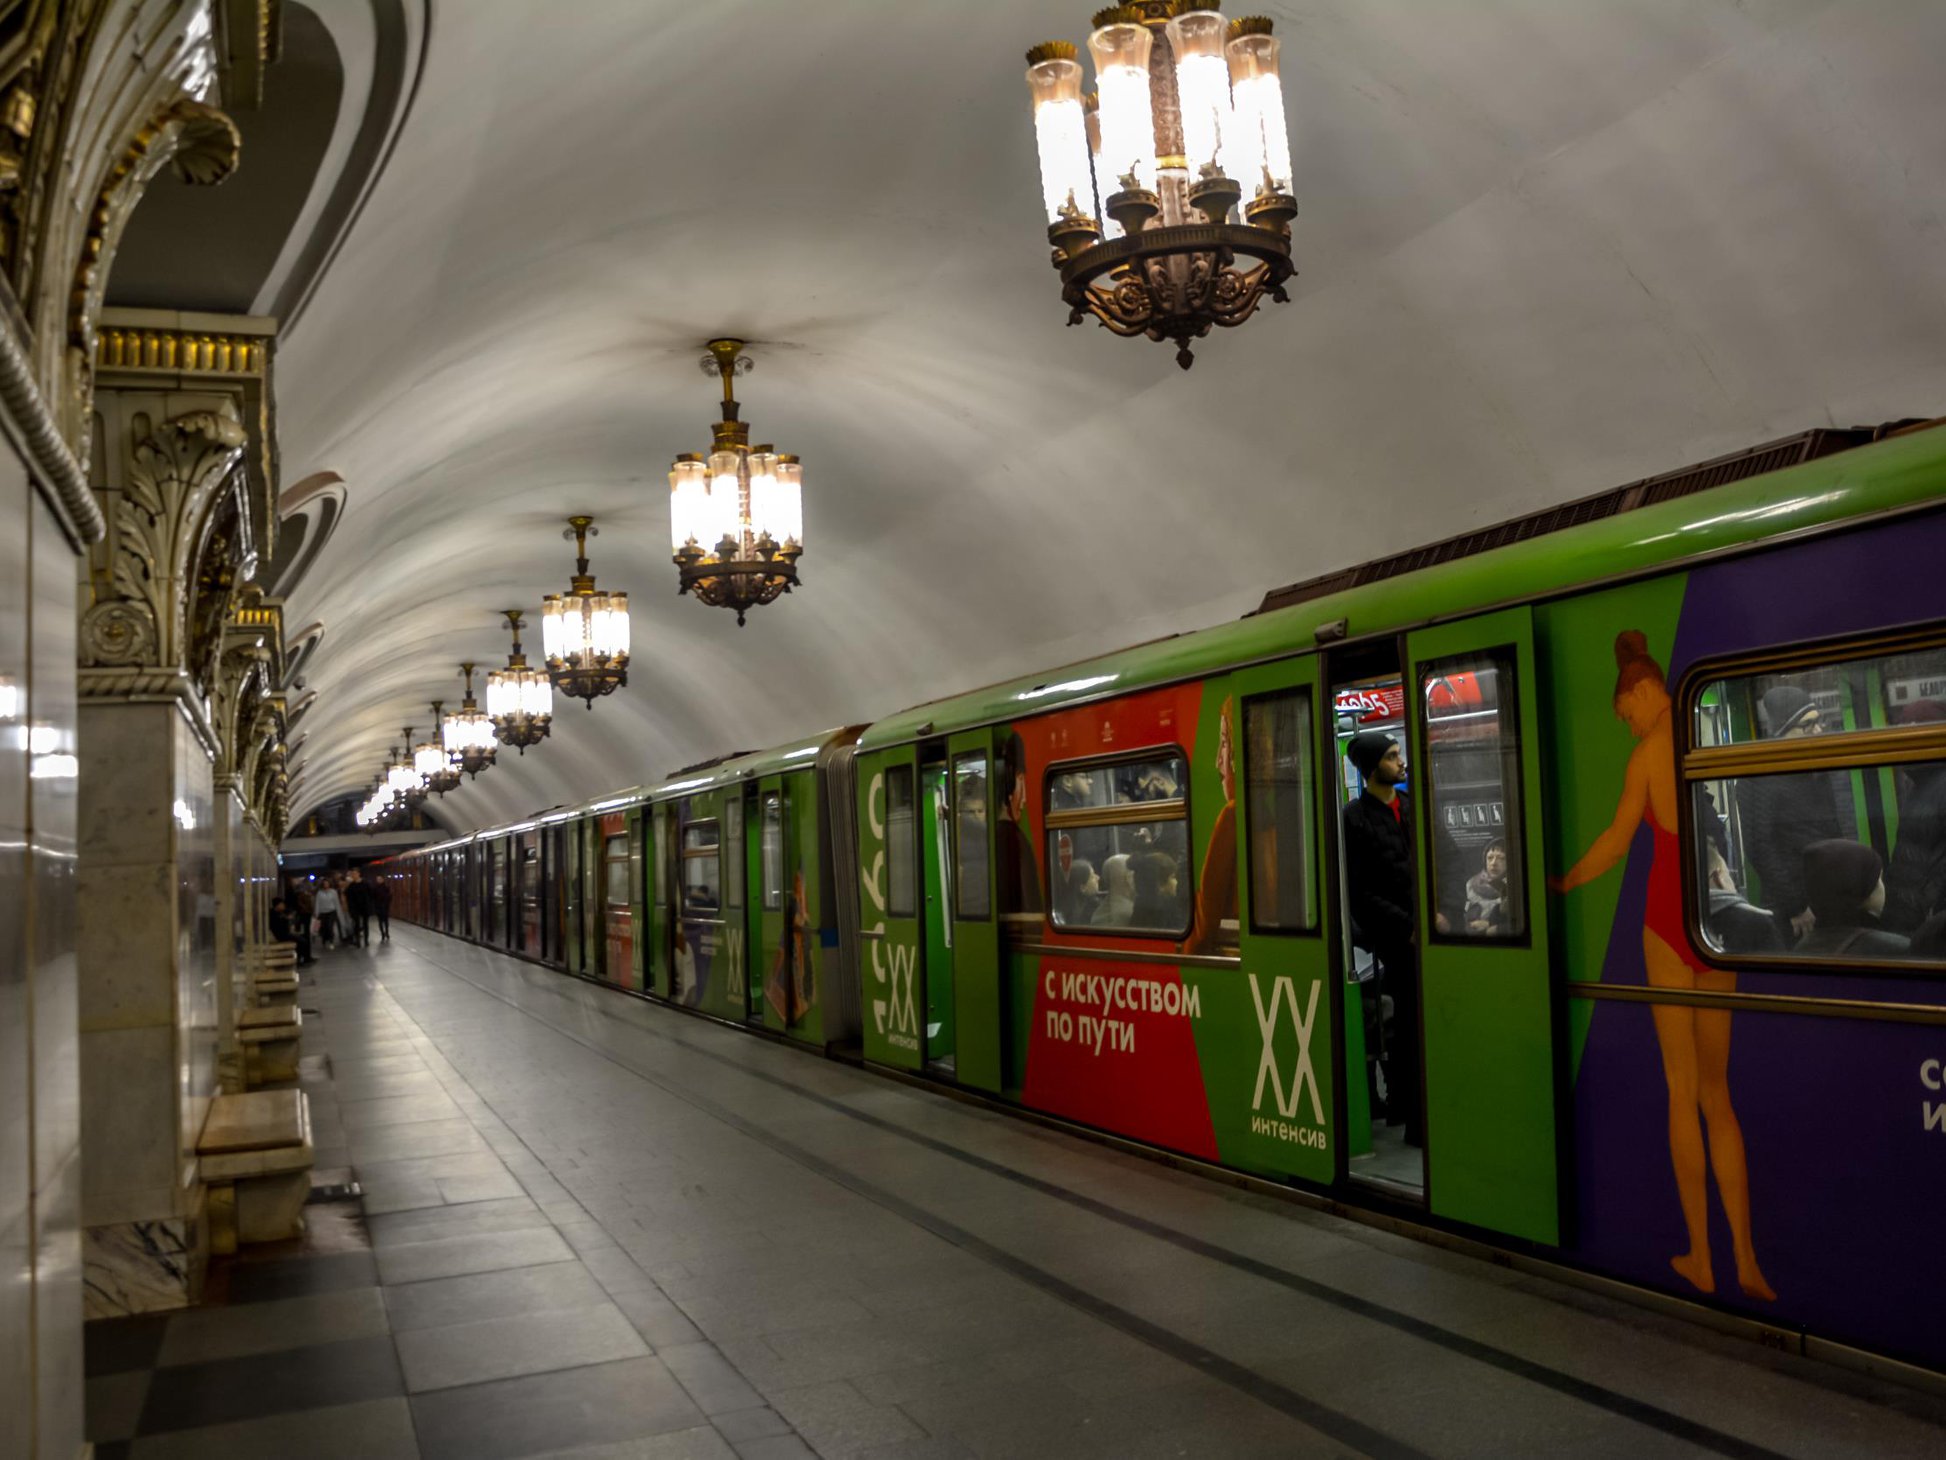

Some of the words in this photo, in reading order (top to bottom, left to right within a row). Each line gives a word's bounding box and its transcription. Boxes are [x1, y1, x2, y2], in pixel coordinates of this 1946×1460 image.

[1062, 973, 1201, 1017] искусством
[1047, 1010, 1072, 1041] по
[1078, 1015, 1135, 1056] пути
[1248, 973, 1325, 1125] XX
[1920, 1058, 1946, 1090] с
[1252, 1115, 1327, 1150] интенсив
